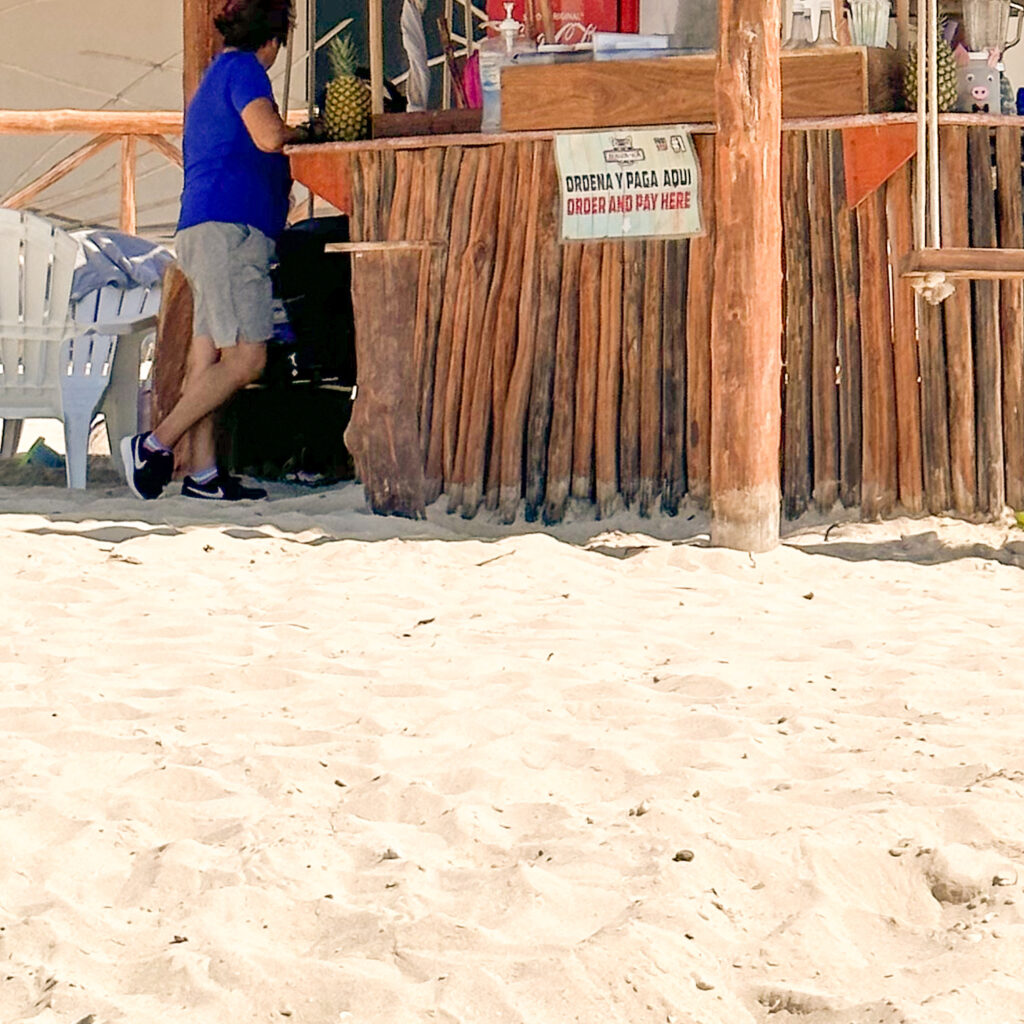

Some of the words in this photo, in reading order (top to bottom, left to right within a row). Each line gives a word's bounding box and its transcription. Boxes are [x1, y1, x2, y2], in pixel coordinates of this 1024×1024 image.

[565, 172, 613, 192] ORDENA
[615, 172, 623, 189] Y
[627, 170, 658, 189] PAGA
[663, 168, 692, 188] AQUI
[567, 196, 606, 216] ORDER
[608, 194, 633, 214] AND
[636, 193, 658, 212] PAY
[661, 191, 691, 210] HERE
